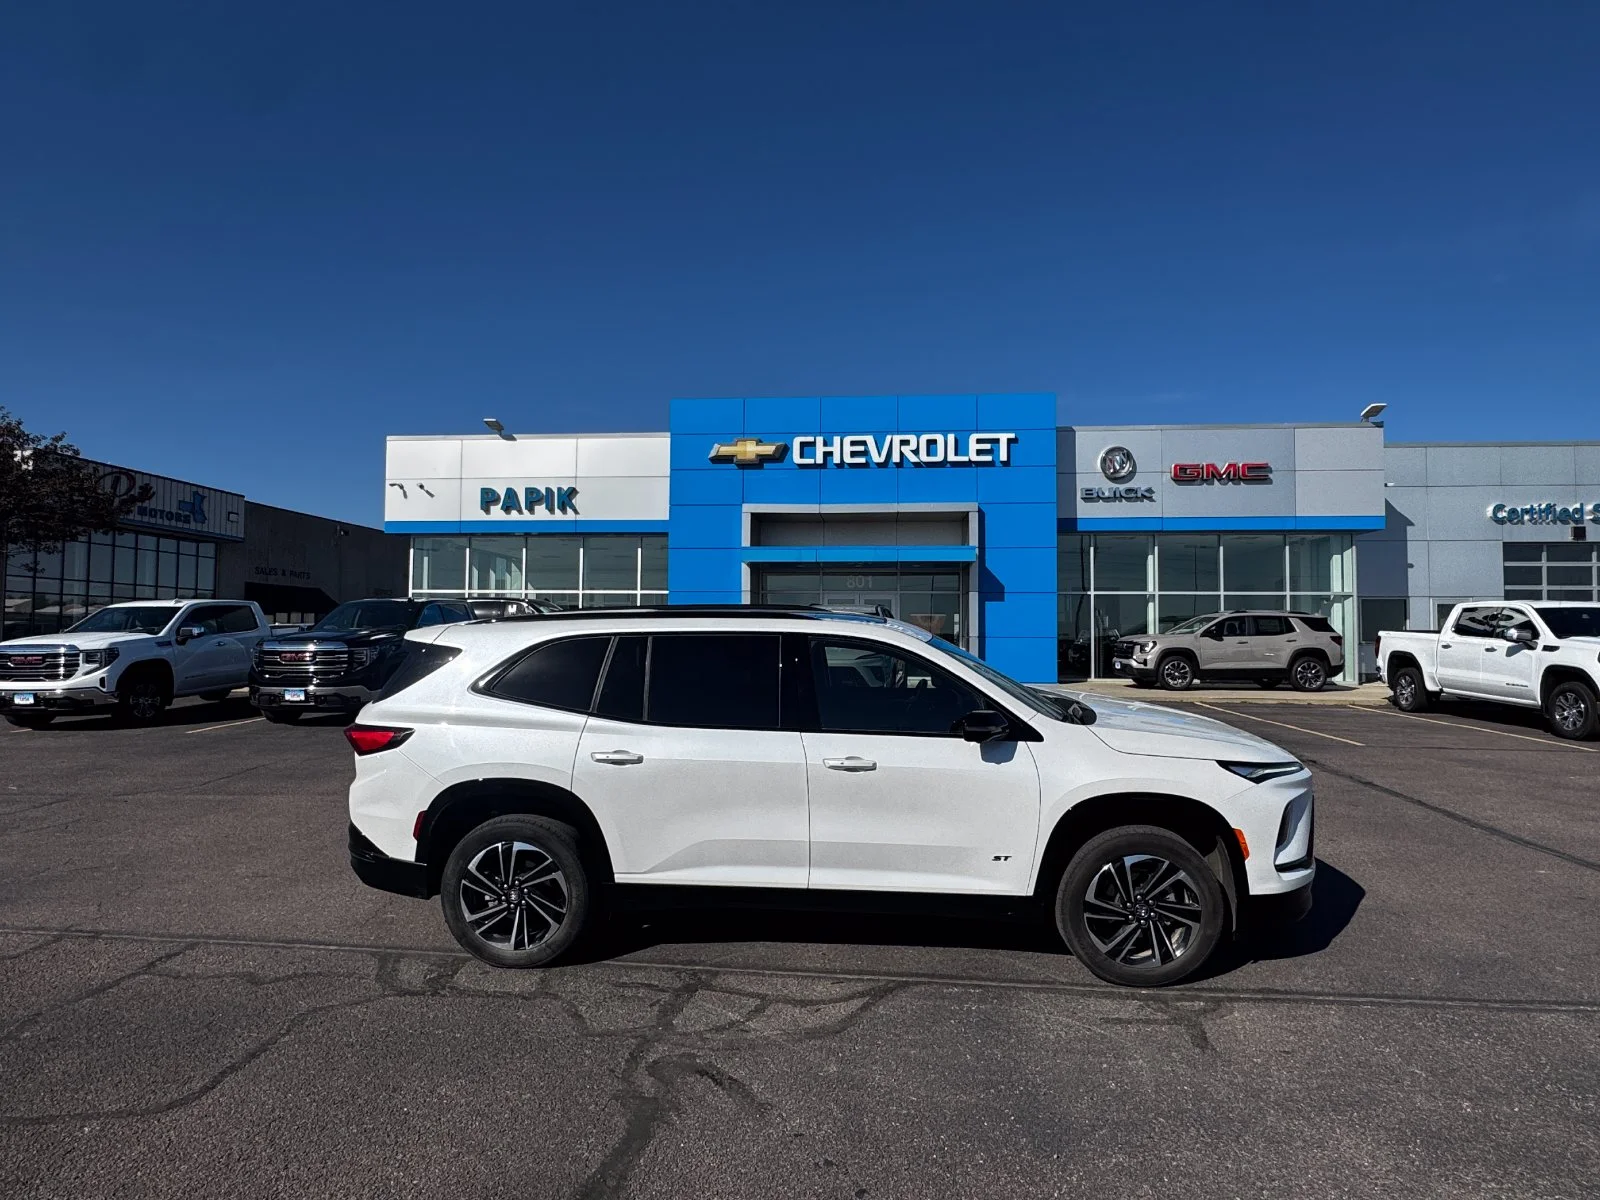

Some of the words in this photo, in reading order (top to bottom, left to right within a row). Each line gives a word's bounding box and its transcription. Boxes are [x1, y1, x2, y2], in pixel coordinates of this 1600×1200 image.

[793, 432, 1016, 465] CHEVROLET
[1170, 462, 1271, 482] GMC
[480, 486, 578, 512] PAPIK
[1080, 486, 1154, 501] BUICK
[137, 505, 191, 524] MOTORS
[1489, 502, 1584, 523] Certified
[254, 566, 278, 577] SALES
[289, 570, 311, 580] PARTS
[846, 575, 873, 588] 801
